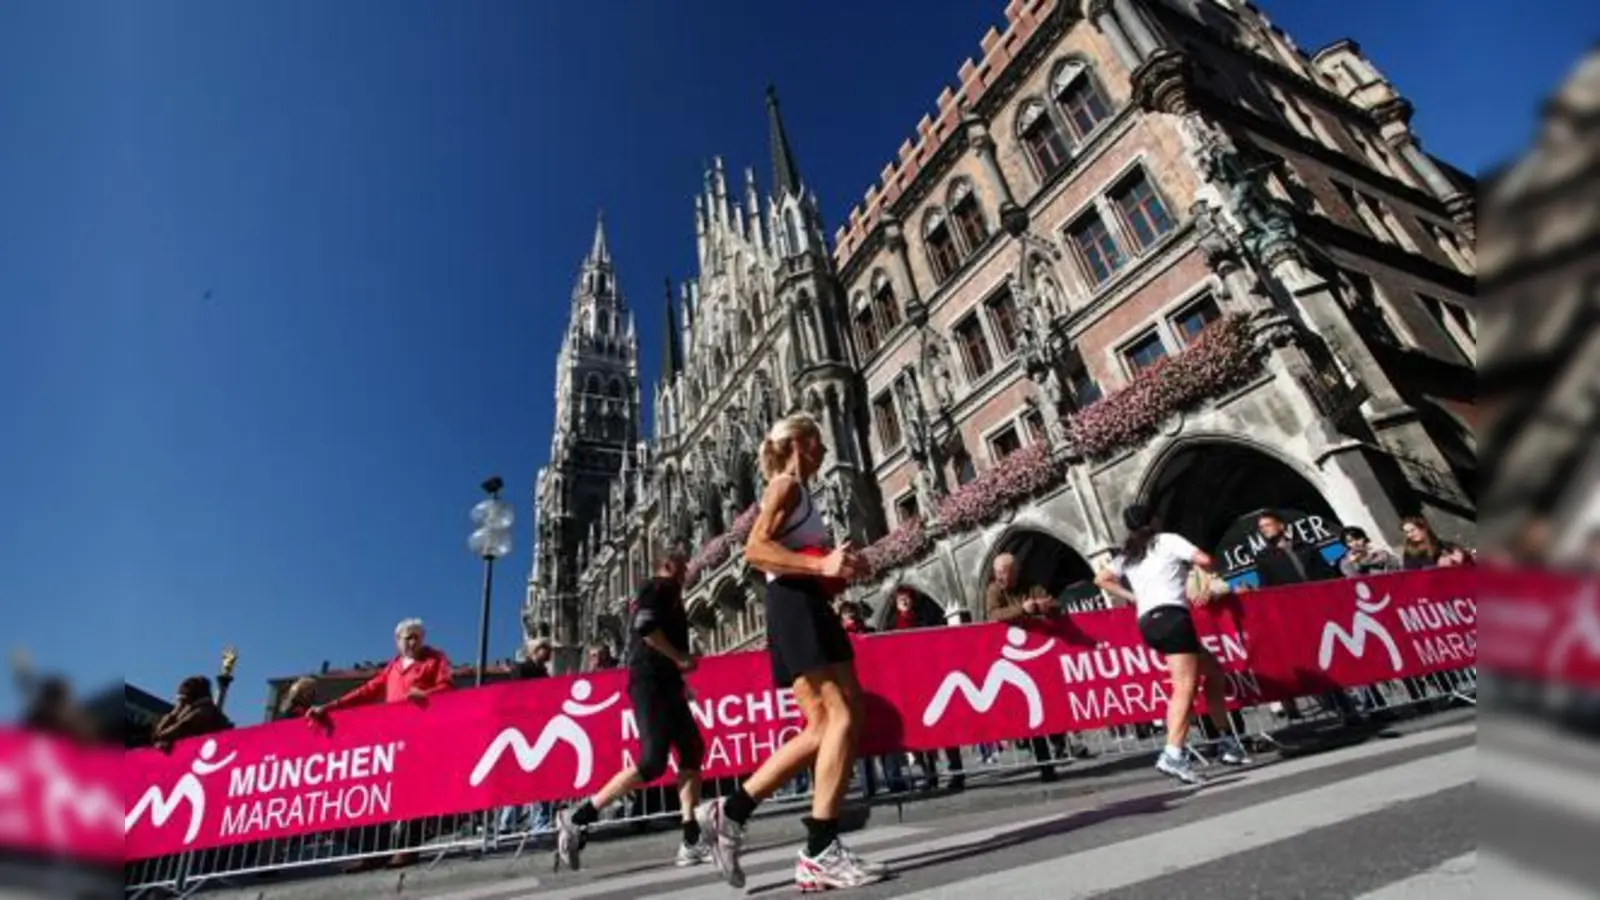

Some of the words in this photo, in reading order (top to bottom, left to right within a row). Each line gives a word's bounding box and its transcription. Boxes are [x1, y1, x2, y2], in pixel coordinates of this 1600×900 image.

[1060, 632, 1249, 684] MÜNCEN
[621, 688, 801, 741] MNCHE
[228, 742, 396, 798] MÜNCHEN
[220, 781, 393, 837] MARATHON
